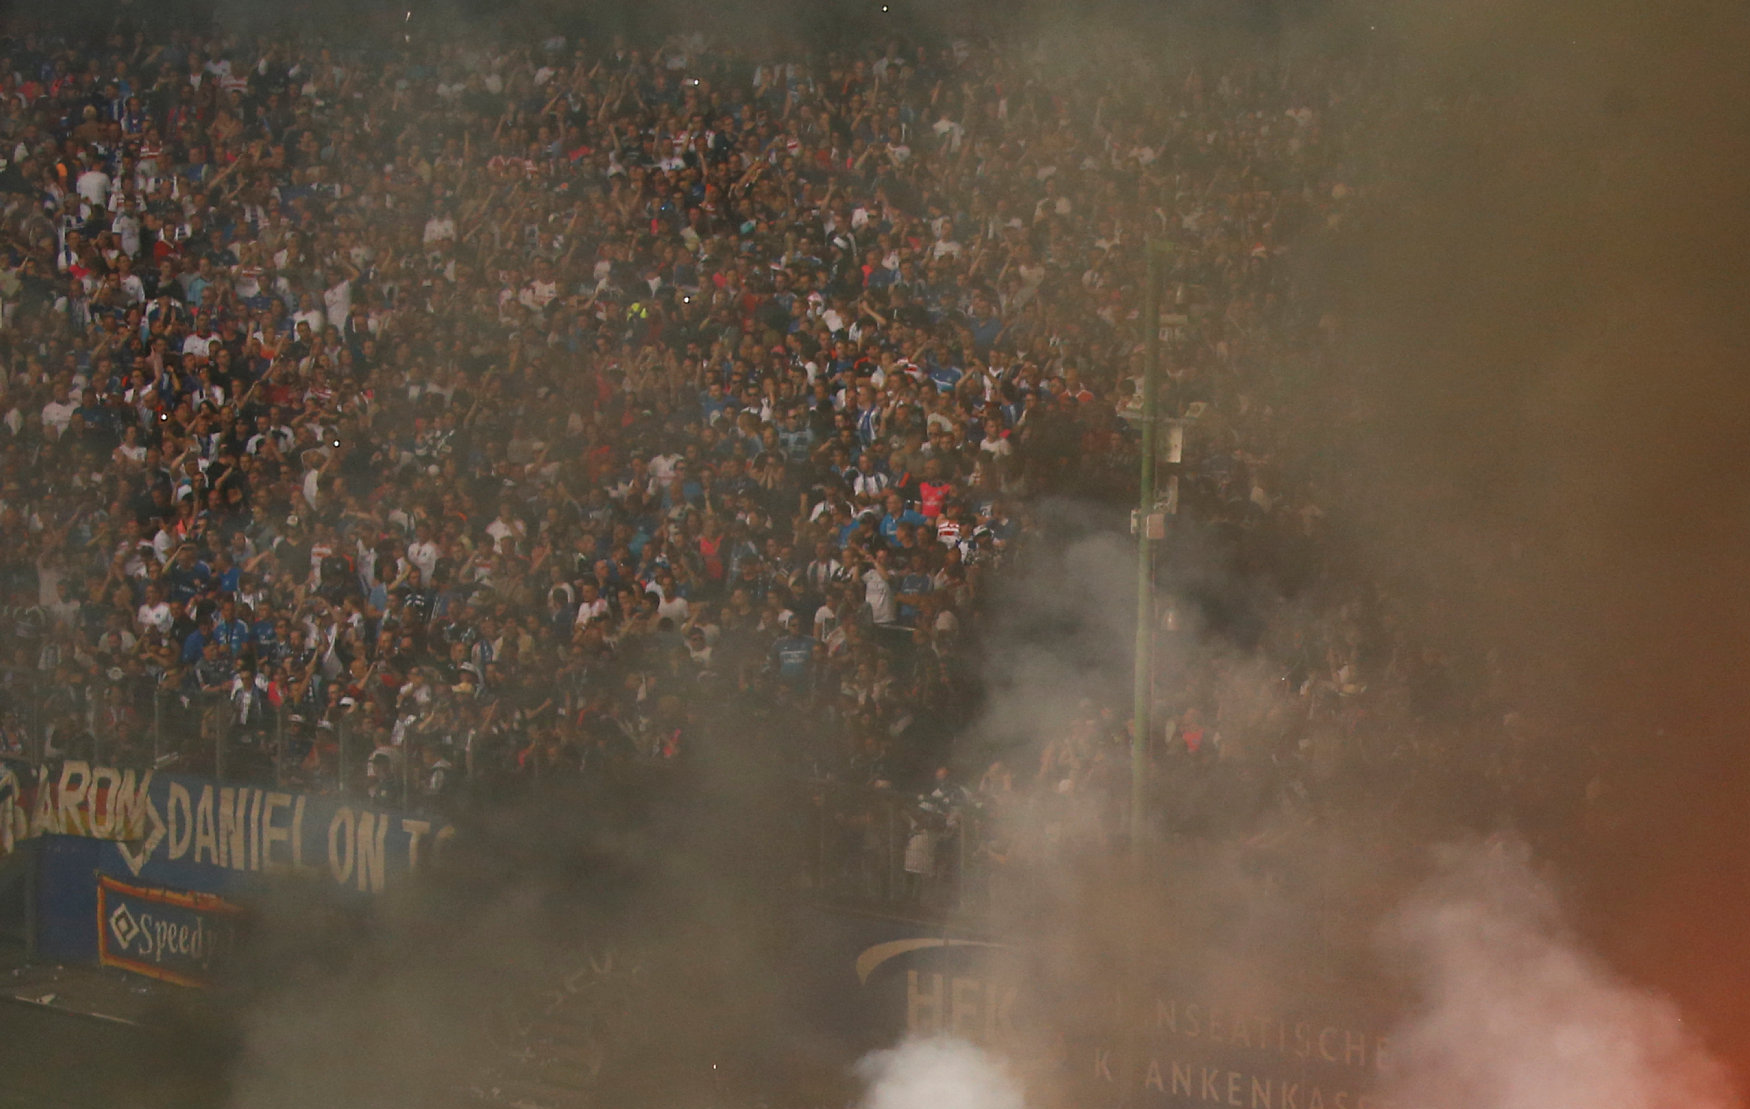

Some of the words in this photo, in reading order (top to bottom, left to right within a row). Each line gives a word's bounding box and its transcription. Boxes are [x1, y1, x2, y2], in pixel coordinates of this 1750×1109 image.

[167, 780, 320, 872] DANIEL
[328, 806, 389, 894] ON
[1100, 990, 1391, 1072] NSEATISCHE
